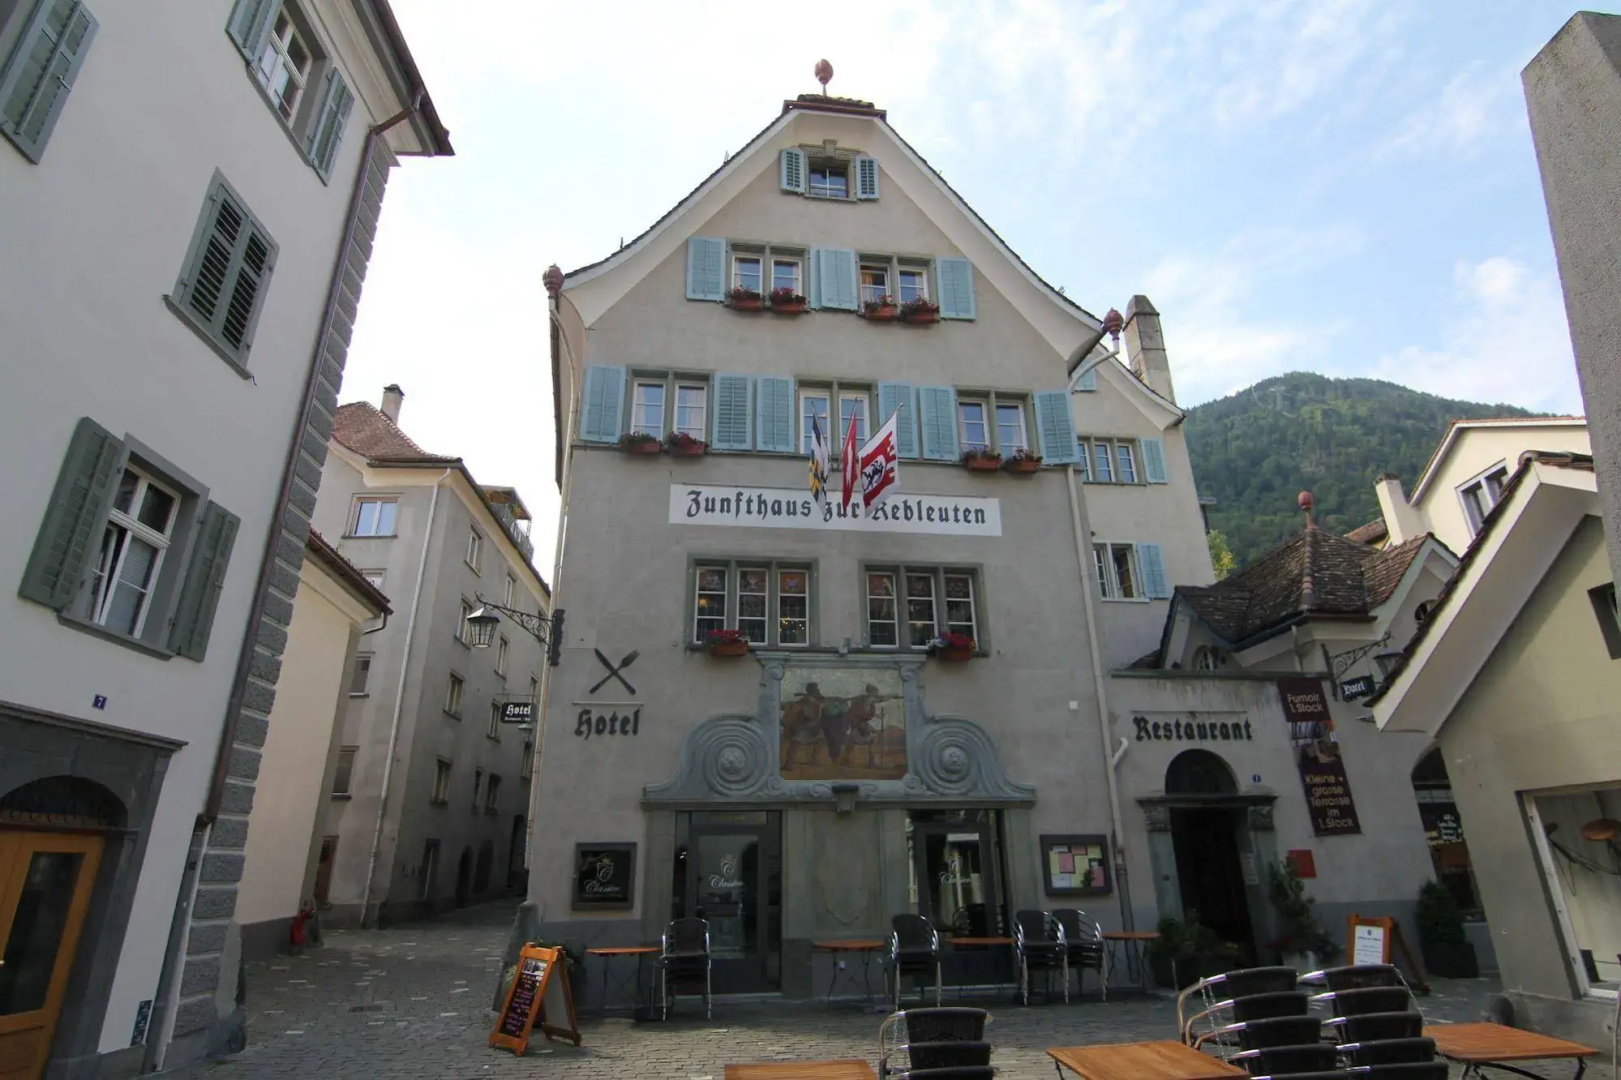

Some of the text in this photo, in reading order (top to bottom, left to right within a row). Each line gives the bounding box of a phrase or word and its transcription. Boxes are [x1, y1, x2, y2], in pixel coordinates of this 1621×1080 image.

[686, 490, 986, 524] Zunfthaus zur Rebleuten
[1344, 682, 1365, 695] Hotel
[1287, 692, 1320, 703] Fumoir
[506, 704, 531, 716] Hotel
[1297, 703, 1324, 713] Stock
[575, 708, 640, 741] Hotel
[1132, 717, 1252, 742] Restaurant
[1305, 774, 1335, 784] Kleine
[1312, 786, 1344, 798] grosse
[1310, 796, 1350, 807] Terrasse
[1327, 808, 1340, 817] im
[1326, 818, 1353, 828] Stock
